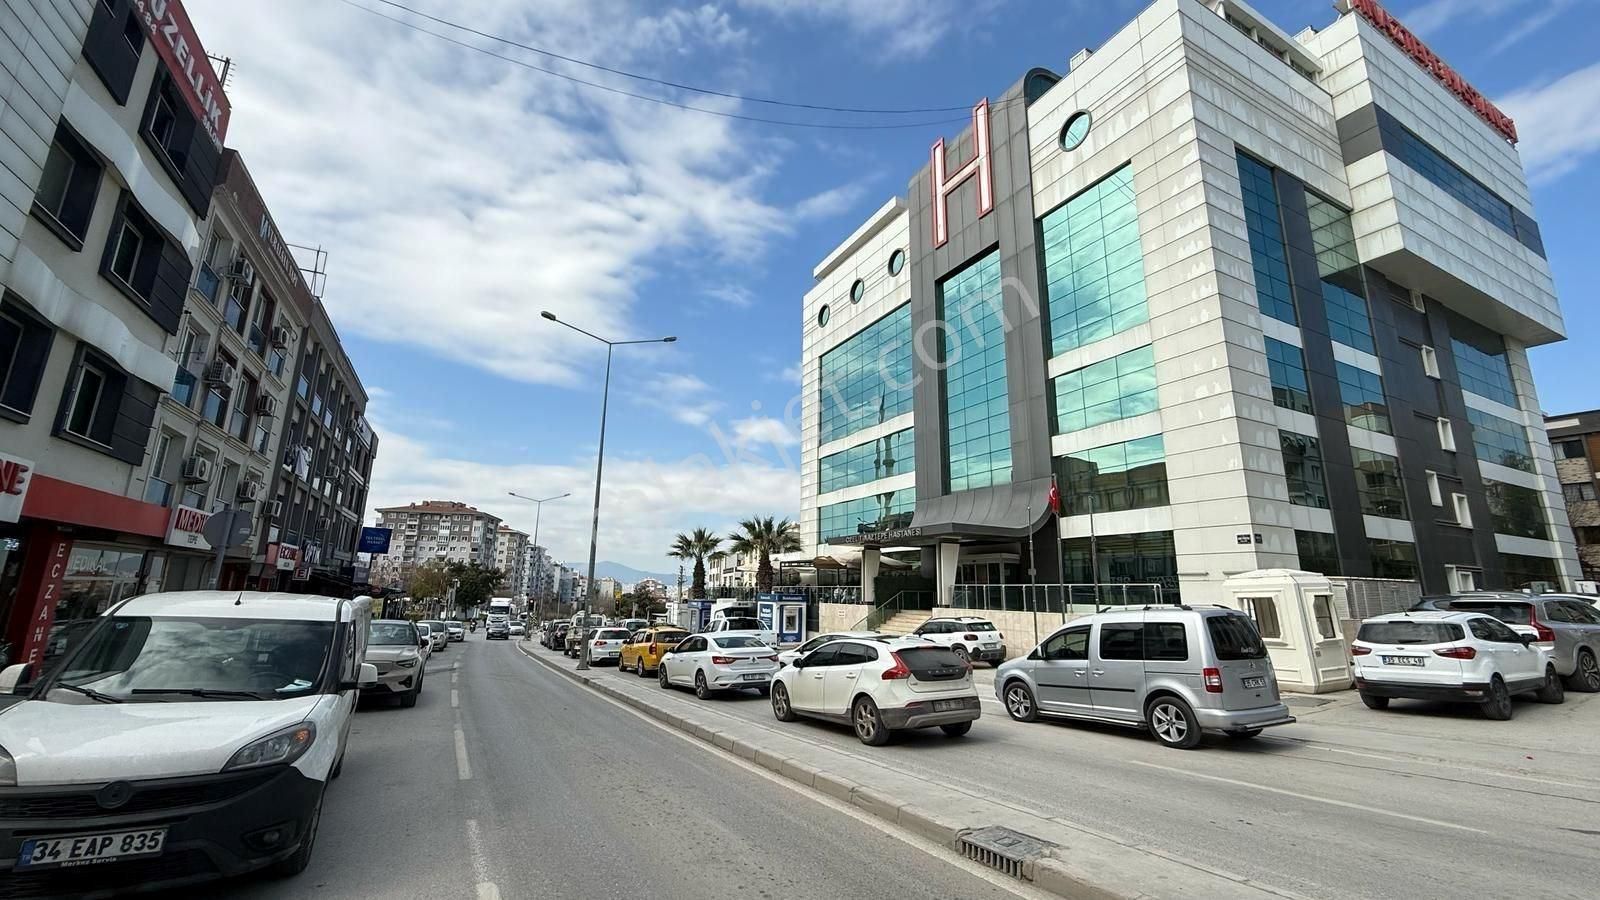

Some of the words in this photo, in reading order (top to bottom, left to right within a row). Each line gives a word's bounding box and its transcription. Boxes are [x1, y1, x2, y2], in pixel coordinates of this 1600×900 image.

[931, 97, 994, 250] H
[28, 543, 66, 664] ECZANE
[32, 841, 61, 862] 34
[69, 836, 113, 858] EAP
[120, 831, 162, 853] 835
